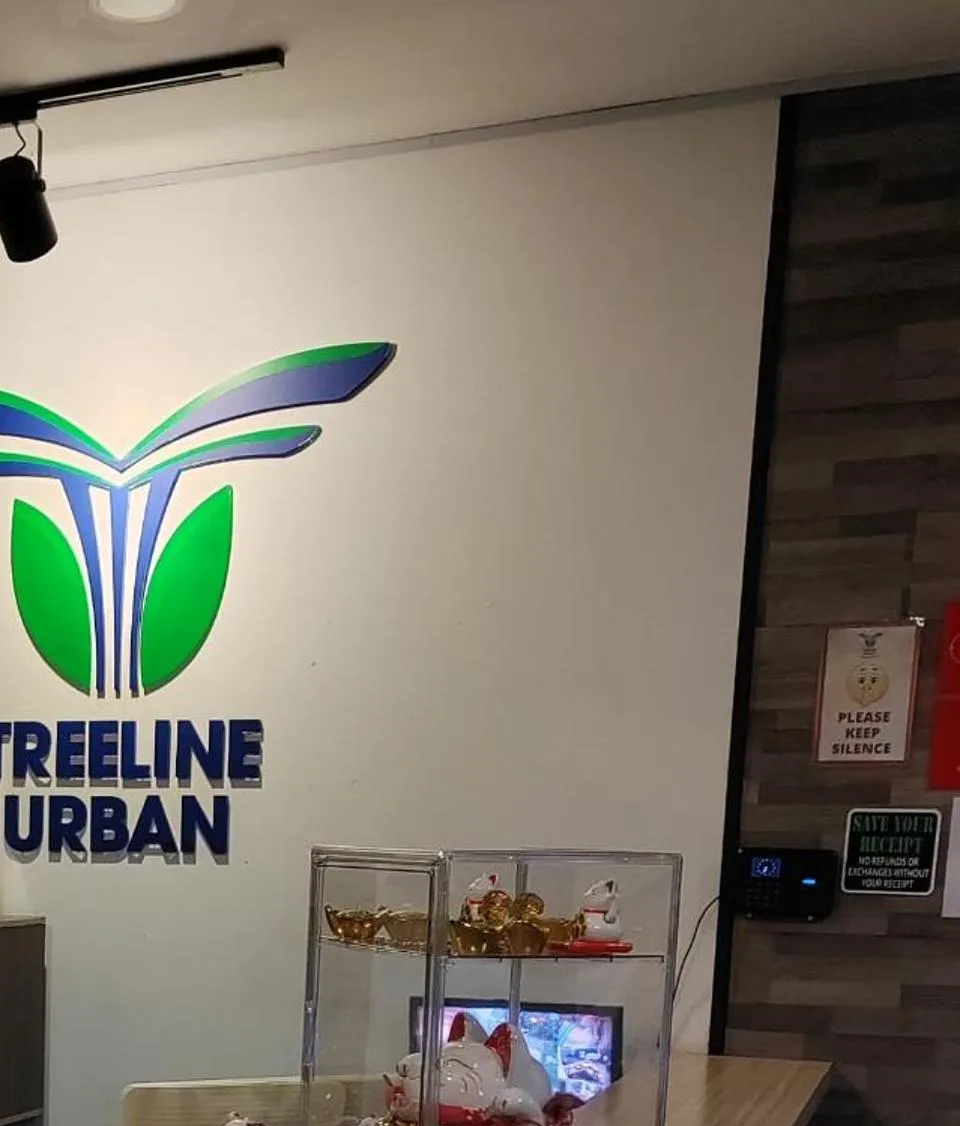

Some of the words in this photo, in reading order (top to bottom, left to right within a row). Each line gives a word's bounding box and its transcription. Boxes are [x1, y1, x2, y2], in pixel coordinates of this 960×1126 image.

[837, 711, 891, 723] PLEASE
[845, 727, 881, 738] KEEP
[832, 743, 891, 754] SILENCE
[4, 795, 230, 855] URBAN
[853, 815, 888, 832] SAVE
[894, 816, 933, 833] YOUR
[860, 836, 924, 853] RECEIPT
[858, 855, 871, 866] NO
